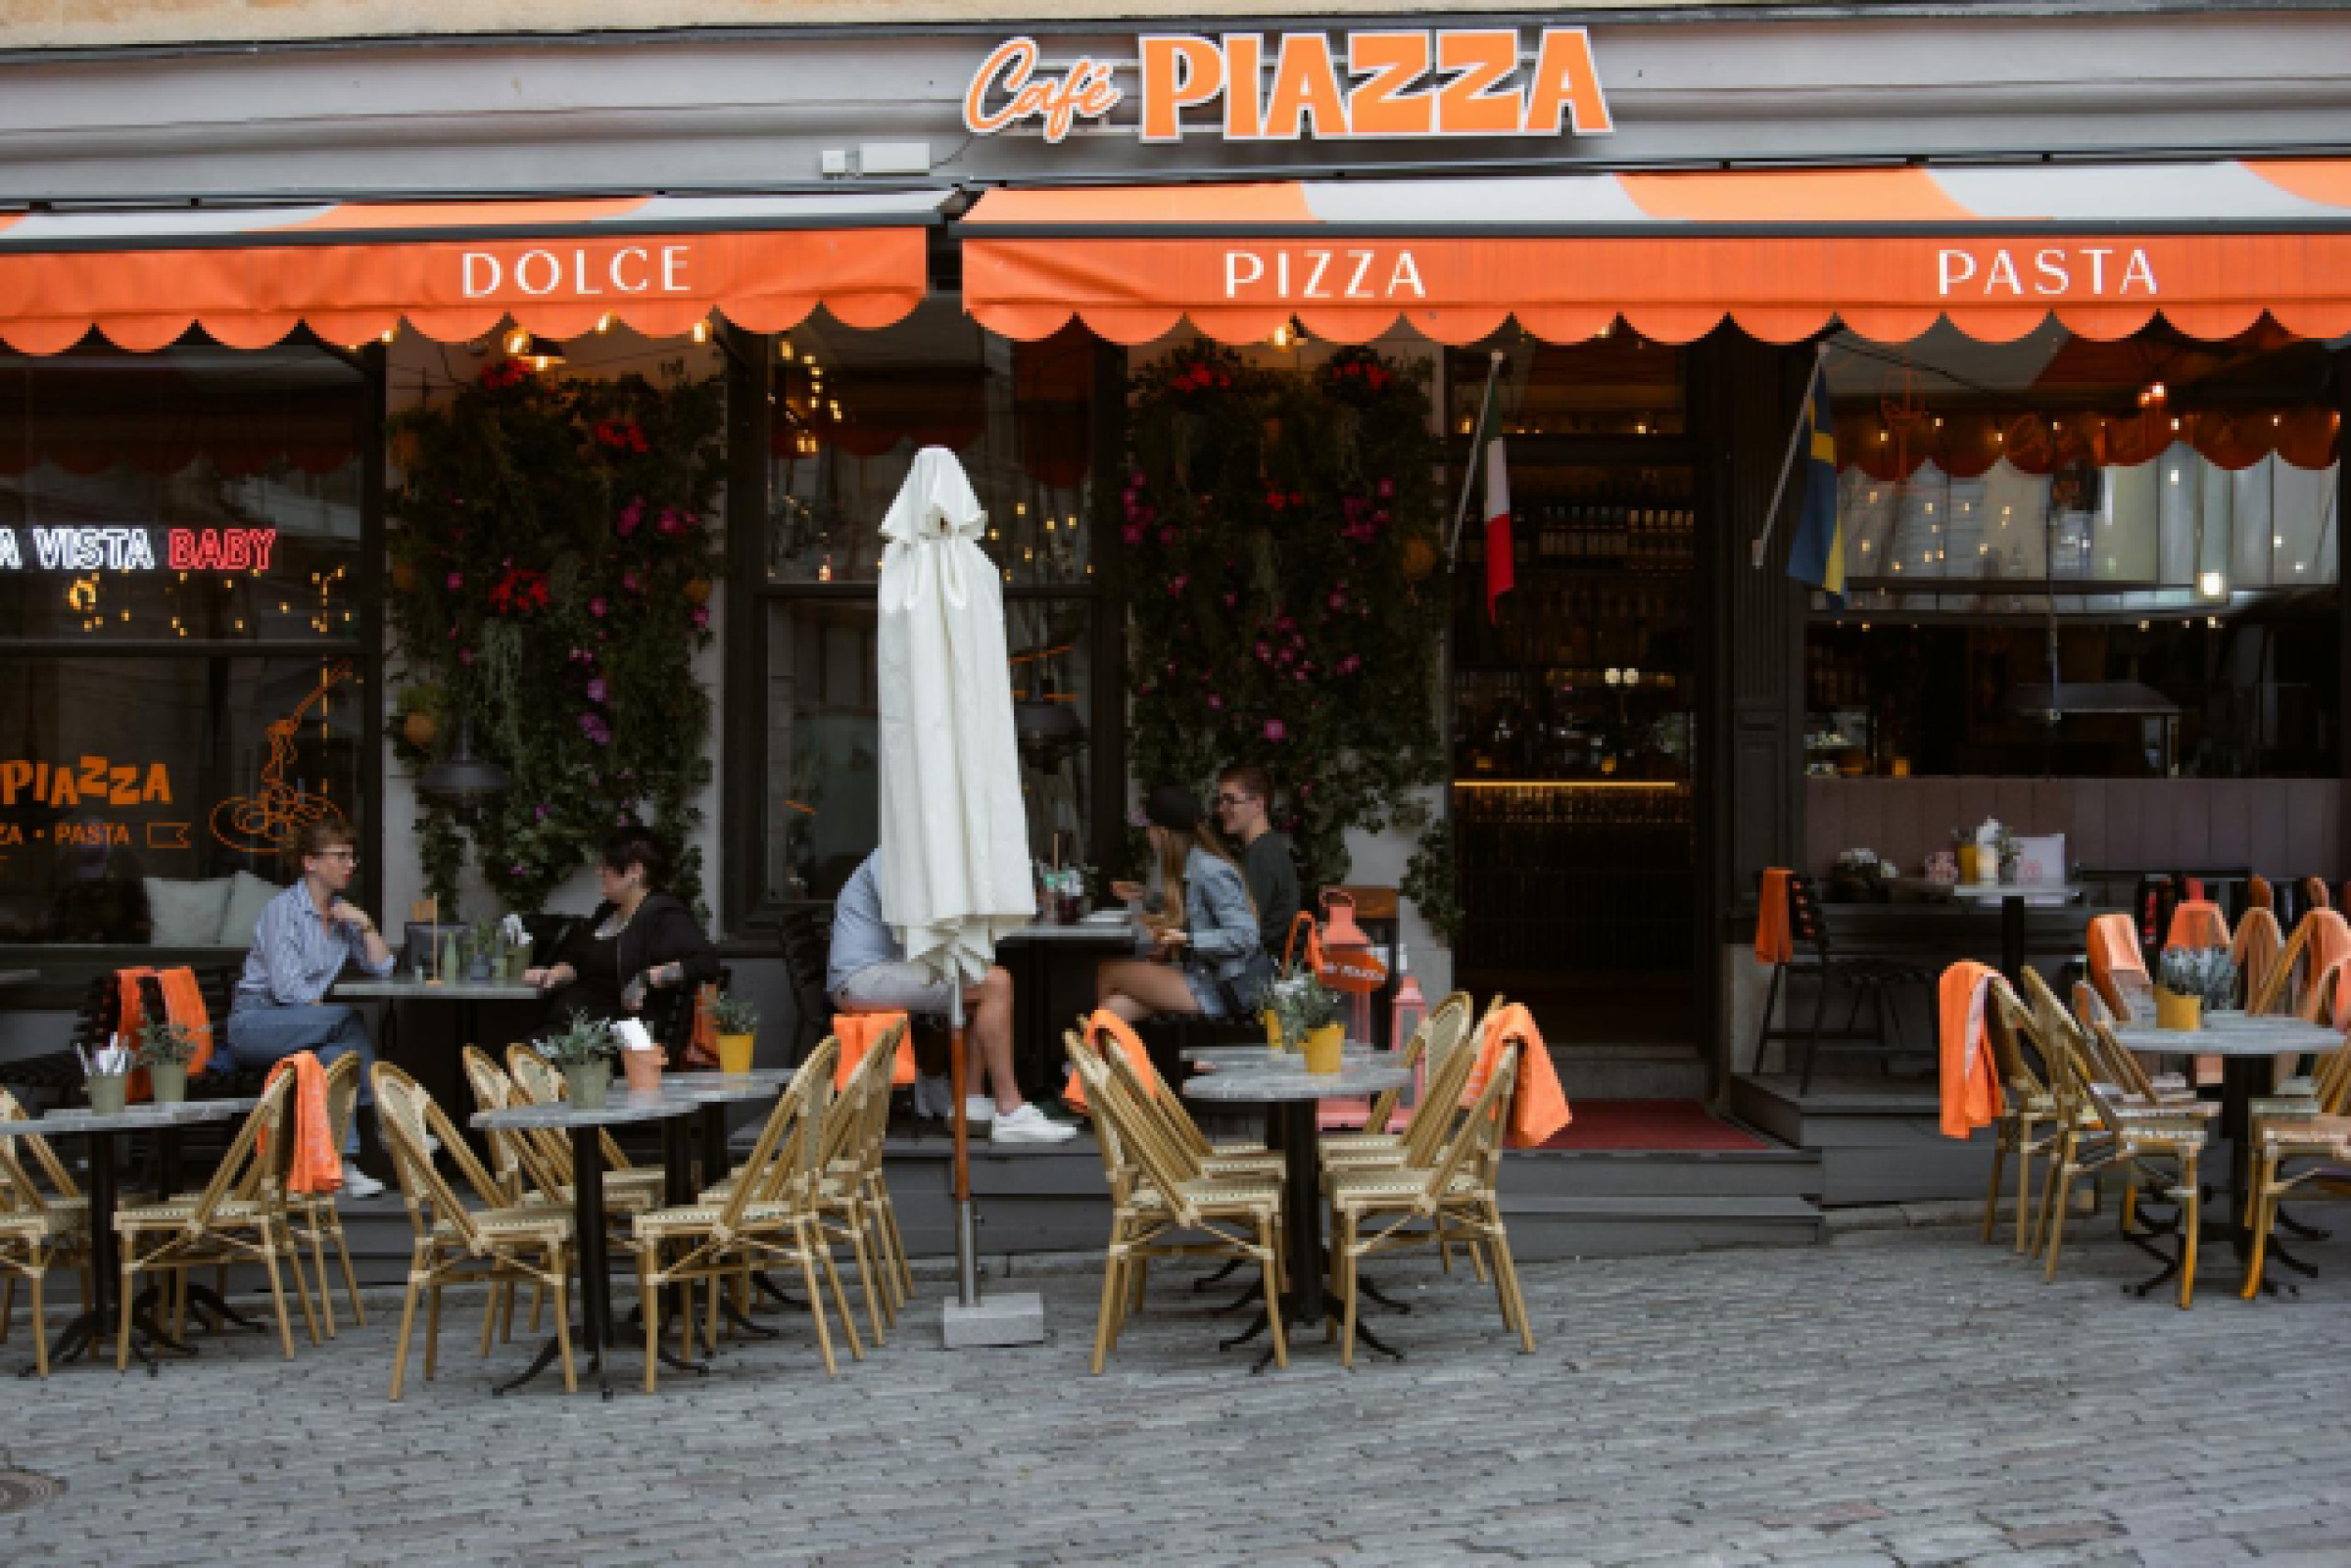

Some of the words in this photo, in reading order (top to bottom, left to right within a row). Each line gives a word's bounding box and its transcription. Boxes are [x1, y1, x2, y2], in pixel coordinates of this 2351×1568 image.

[963, 35, 1123, 143] Café
[1138, 27, 1614, 141] PIAZZA
[462, 245, 692, 299] DOLCE
[1224, 249, 1426, 299] PIZZA
[1937, 247, 2161, 298] PASTA
[32, 525, 155, 570] VISTA
[168, 527, 277, 570] BABY
[0, 753, 173, 808] PIAZZA
[54, 822, 131, 846] PASTA
